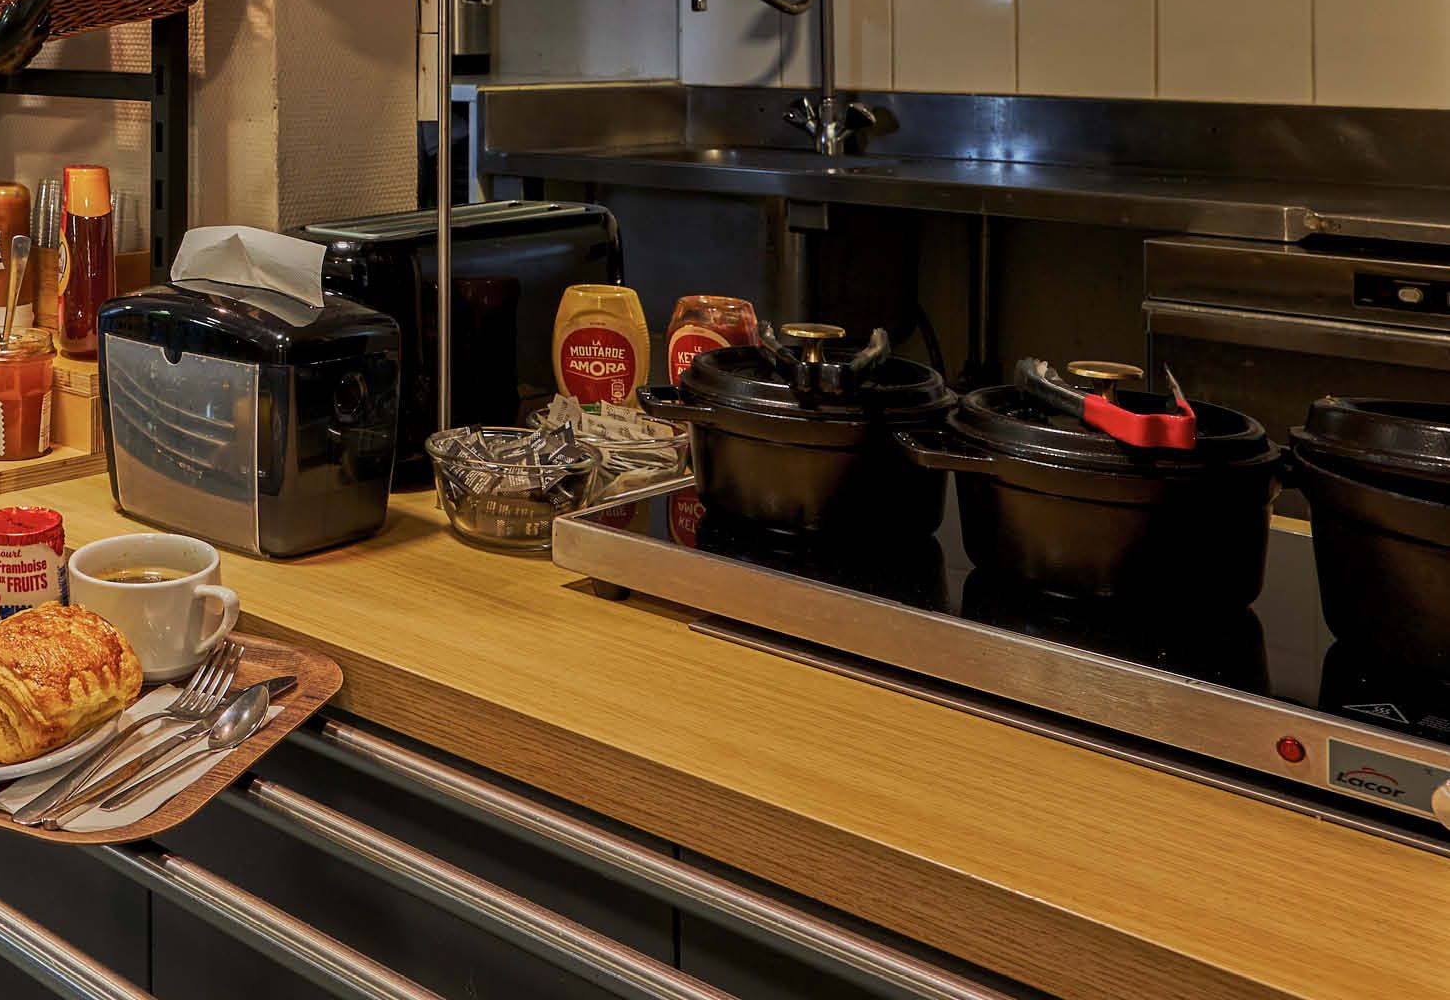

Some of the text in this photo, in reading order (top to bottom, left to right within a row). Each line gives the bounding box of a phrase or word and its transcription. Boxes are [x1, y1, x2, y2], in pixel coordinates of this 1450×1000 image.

[570, 346, 626, 359] MOUTARDE
[678, 352, 695, 364] KET
[570, 360, 626, 376] AMORA
[7, 573, 48, 592] FRUITS
[1336, 771, 1407, 798] Lacor
